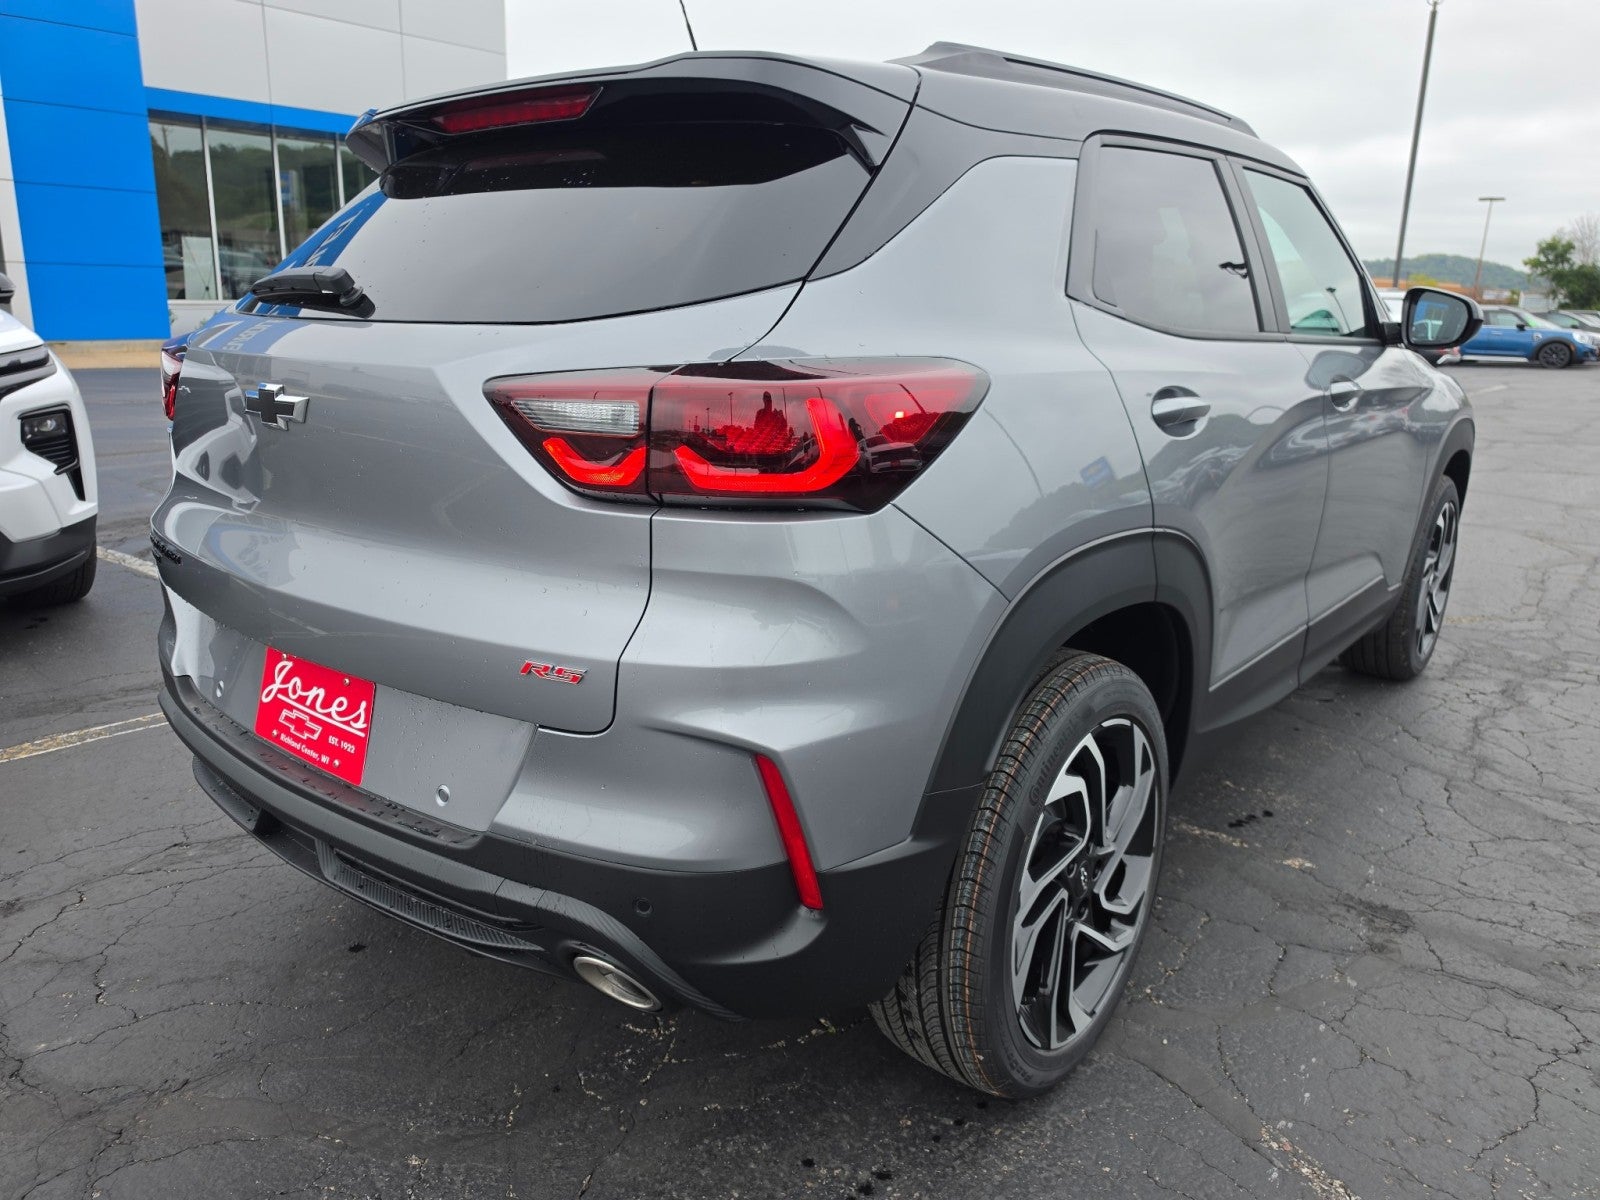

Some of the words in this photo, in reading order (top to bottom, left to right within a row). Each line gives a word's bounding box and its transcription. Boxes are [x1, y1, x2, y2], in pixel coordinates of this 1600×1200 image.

[520, 660, 587, 685] RS
[261, 660, 368, 729] Jones
[280, 733, 301, 750] Richland
[320, 754, 330, 765] WI
[328, 735, 339, 747] EST.
[340, 741, 356, 754] 1922
